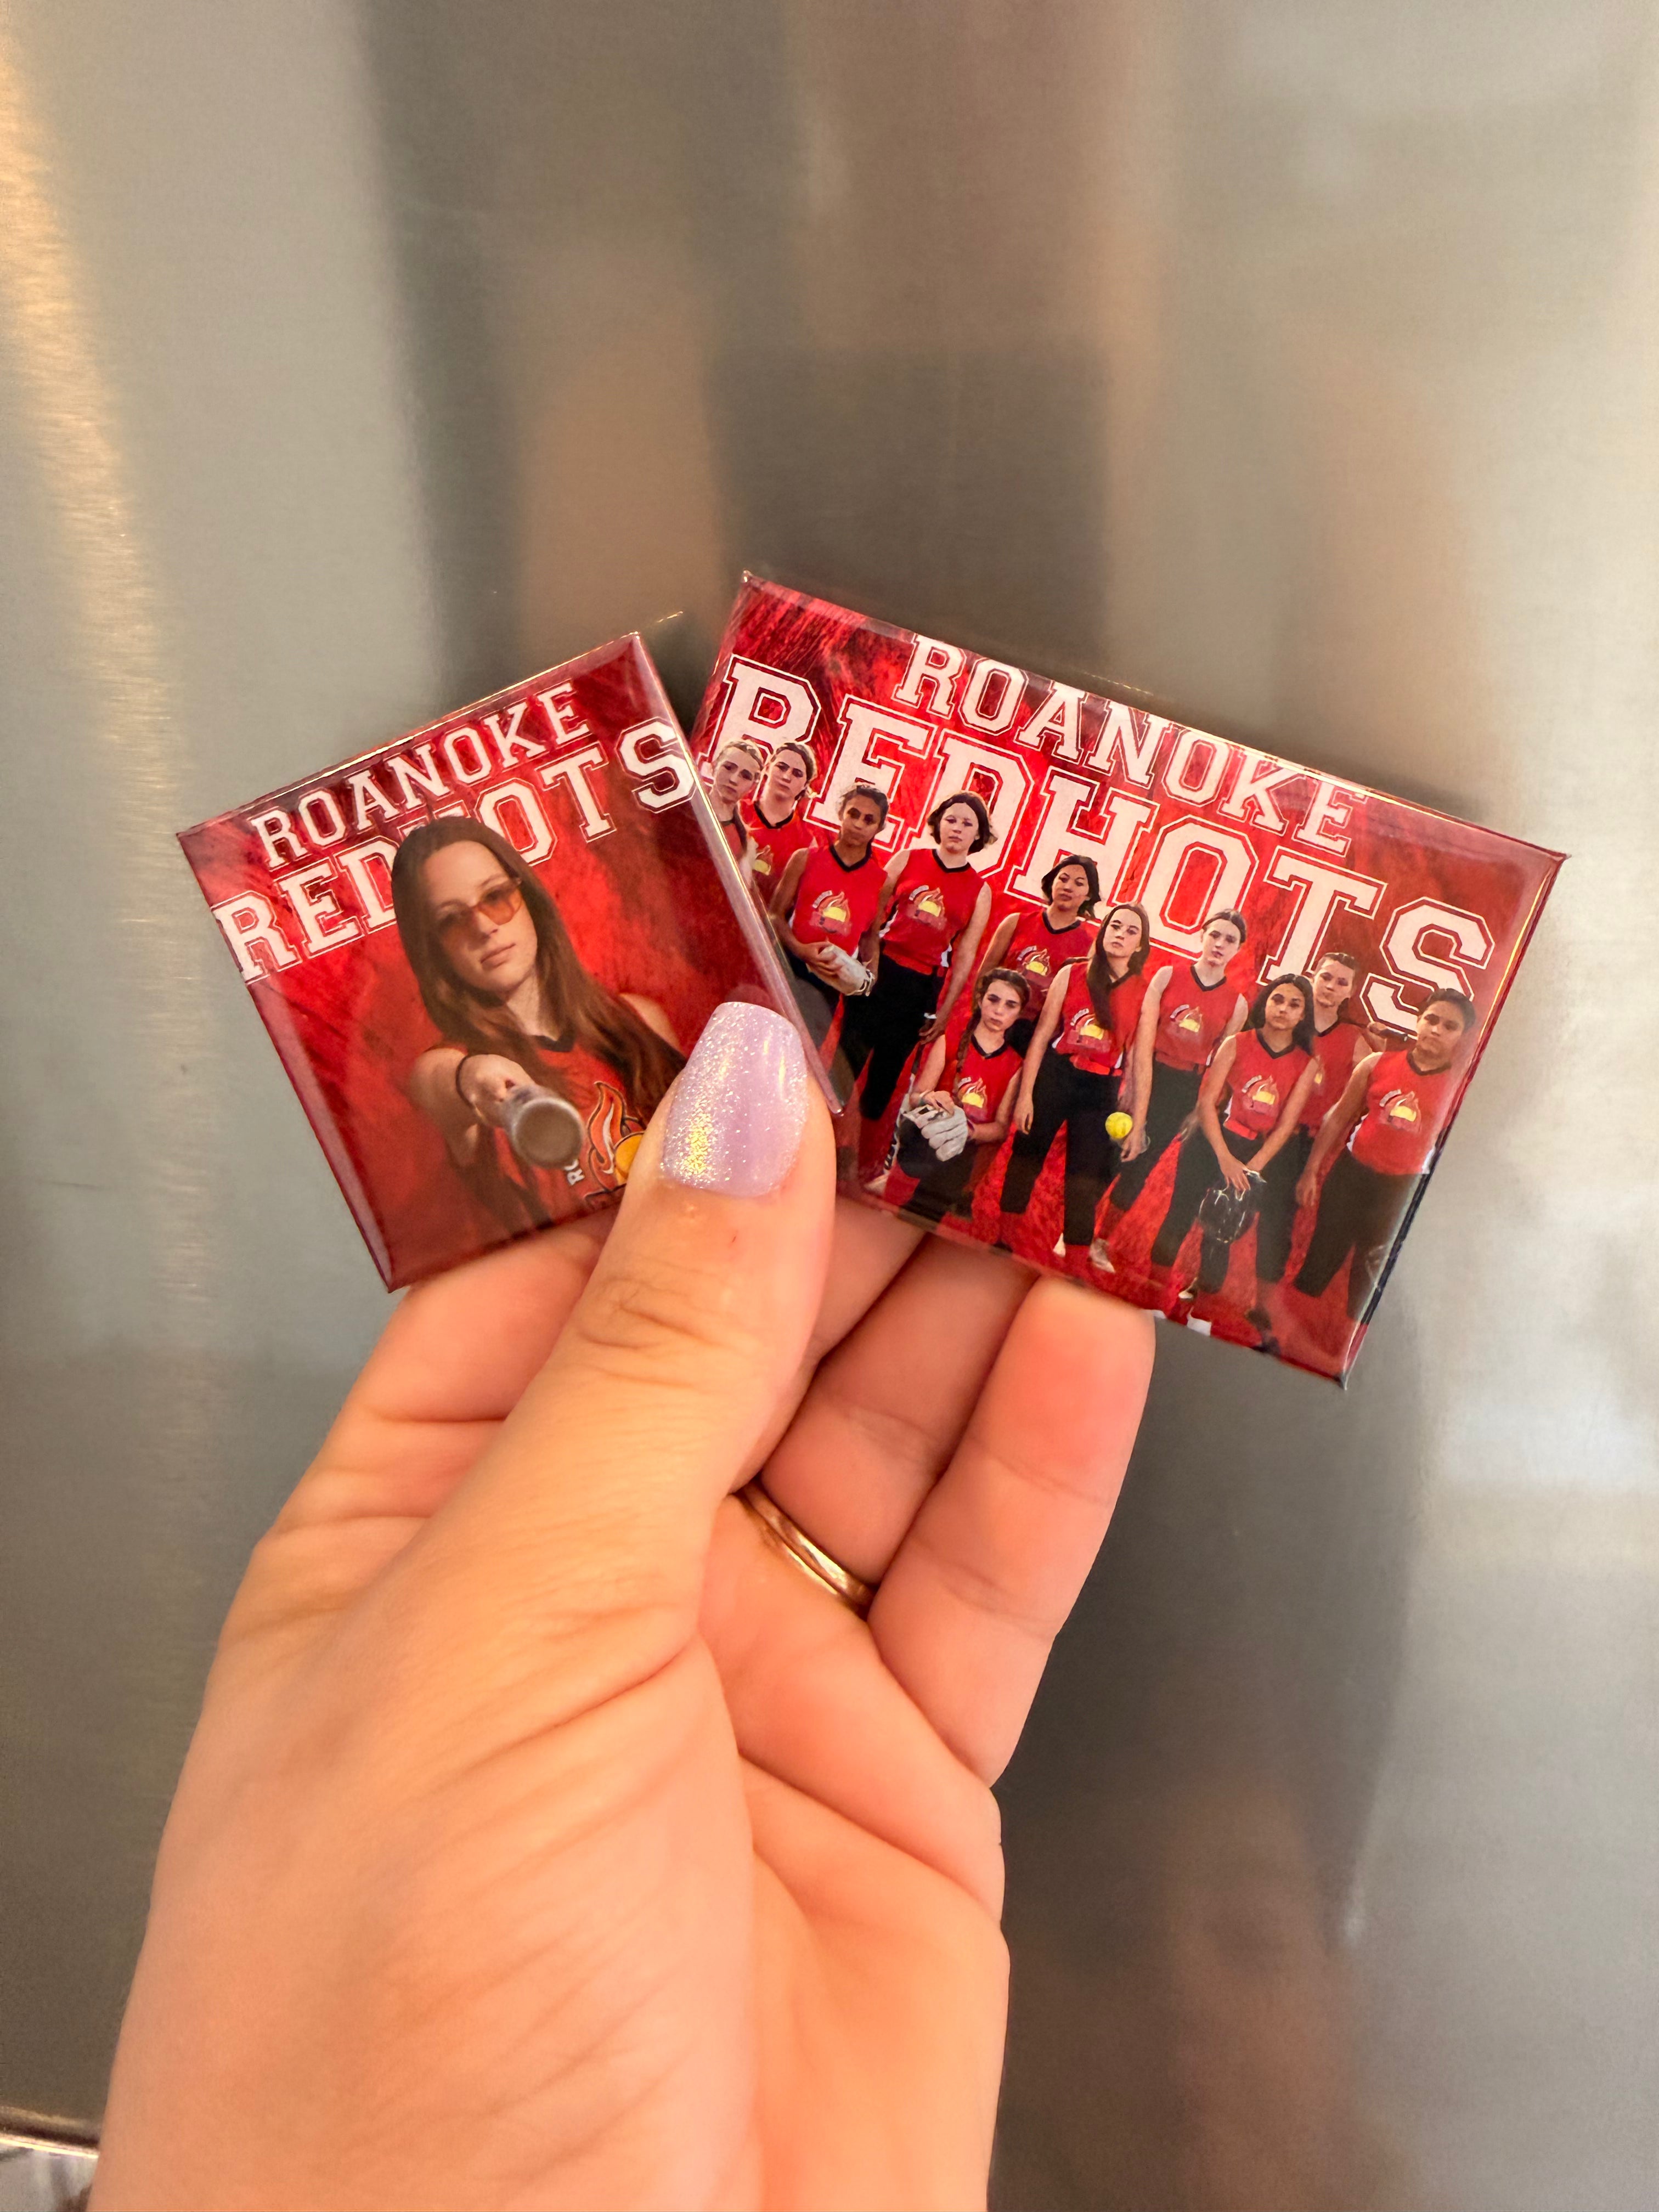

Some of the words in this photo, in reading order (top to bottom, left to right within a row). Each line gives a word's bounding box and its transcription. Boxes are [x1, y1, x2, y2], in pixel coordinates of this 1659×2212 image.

[211, 716, 697, 985] REDOTS
[249, 680, 591, 870] ROANOKE
[890, 633, 1368, 858] ROANOKE
